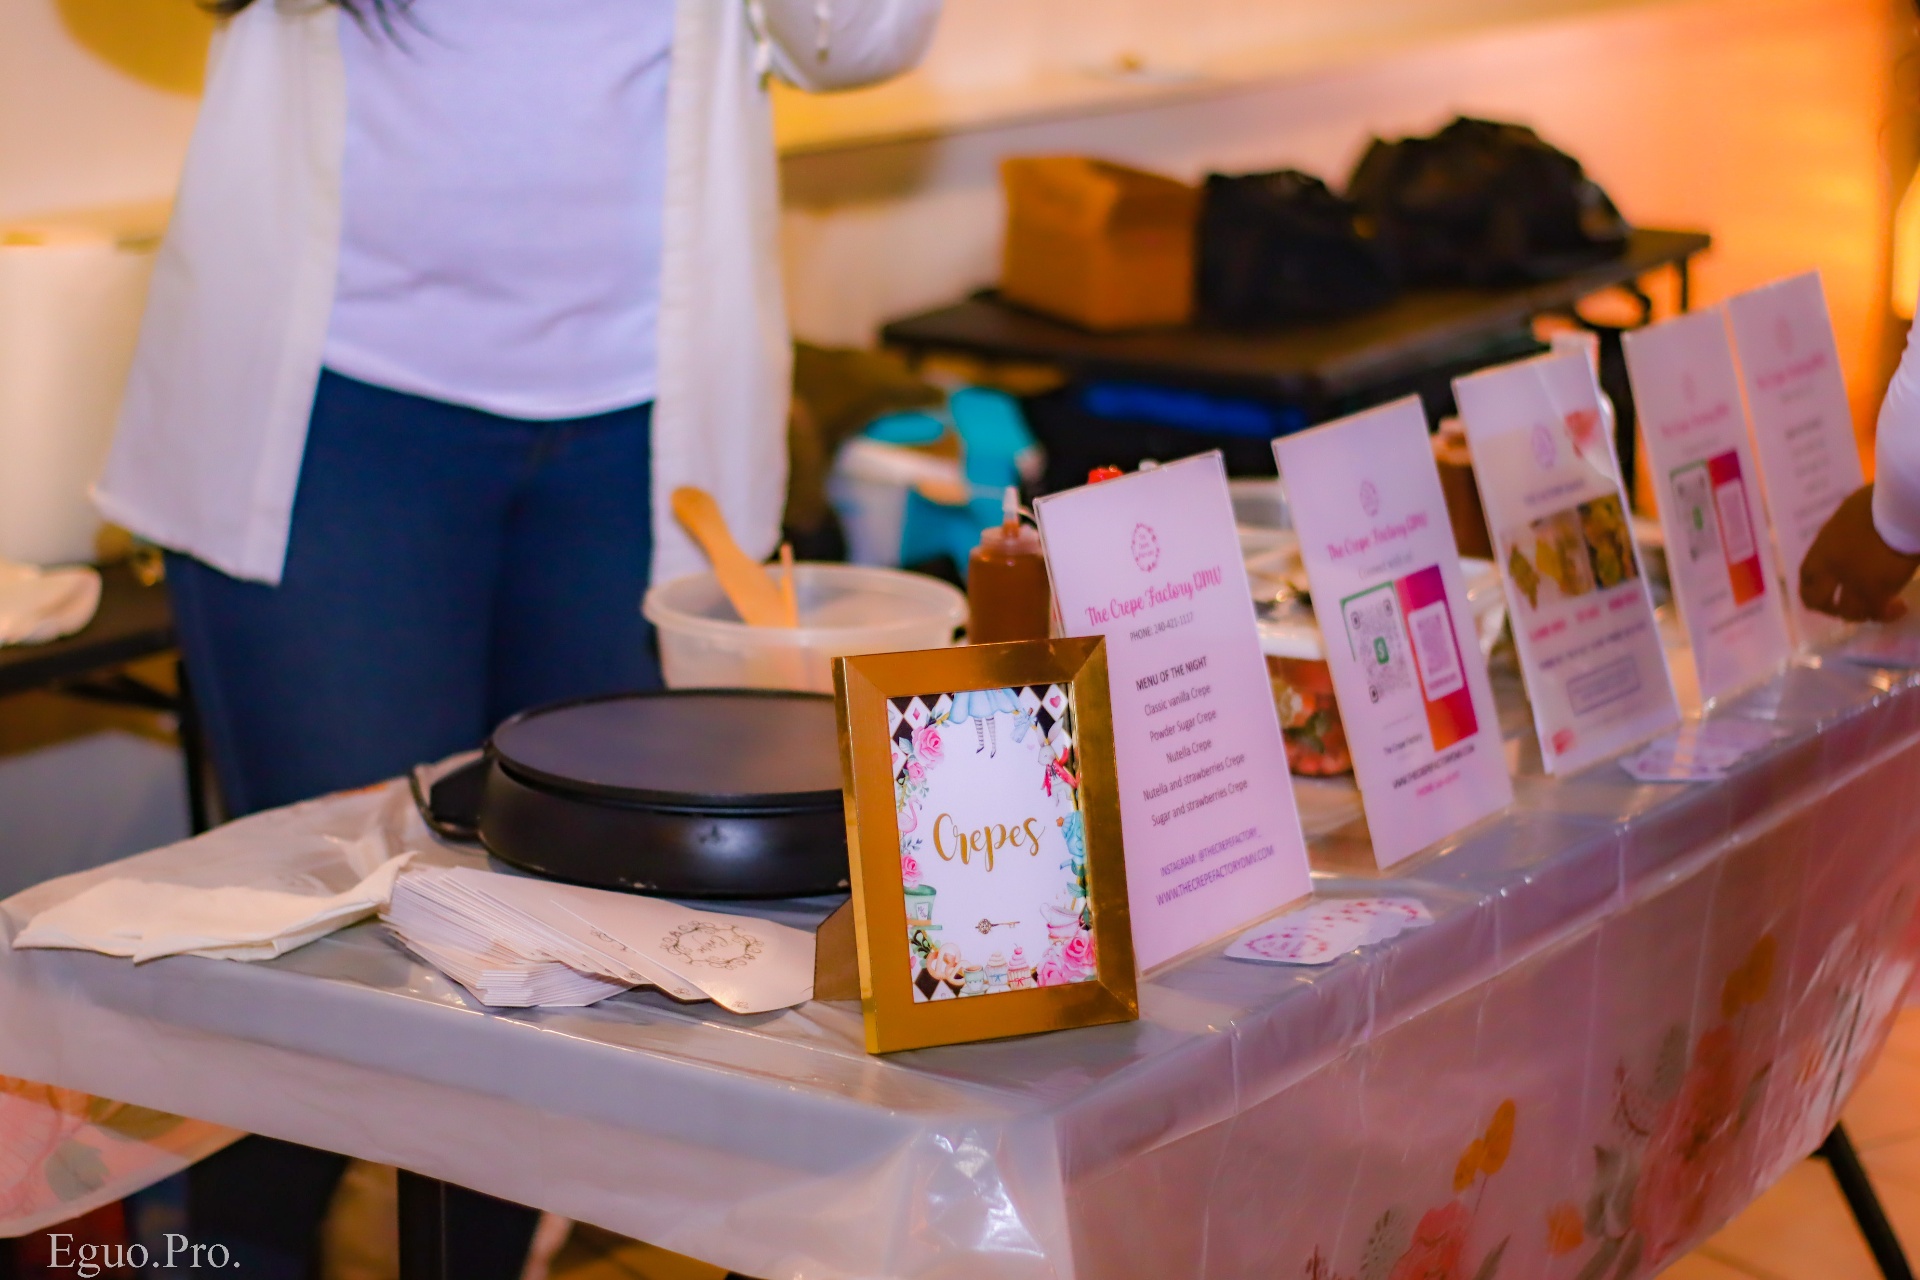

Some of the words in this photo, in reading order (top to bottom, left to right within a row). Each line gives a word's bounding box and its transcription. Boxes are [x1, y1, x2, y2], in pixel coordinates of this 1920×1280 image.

[1085, 606, 1109, 626] The
[1110, 595, 1145, 619] Crepe
[1146, 581, 1194, 608] Factory
[1129, 626, 1153, 641] PHONE:
[1136, 673, 1158, 691] MENU
[1160, 670, 1171, 683] OF
[1171, 663, 1186, 679] THE
[1185, 656, 1208, 674] NIGHT
[1144, 699, 1168, 717] Classic
[1168, 690, 1191, 708] vanilla
[1190, 683, 1211, 700] Crepe
[1150, 723, 1176, 742] Powder
[1176, 716, 1196, 733] Sugar
[1196, 708, 1217, 725] Crepe
[1166, 745, 1191, 764] Nutella
[1191, 737, 1213, 754] Crepe
[1143, 782, 1169, 802] Nutella
[1169, 777, 1183, 792] and
[1183, 760, 1225, 785] strawberries
[1225, 752, 1246, 770] Crepe
[1151, 810, 1171, 827] Sugar
[1172, 803, 1186, 818] and
[1186, 786, 1227, 811] strawberries
[1227, 778, 1248, 796] Crepe
[933, 812, 1046, 873] Crepes
